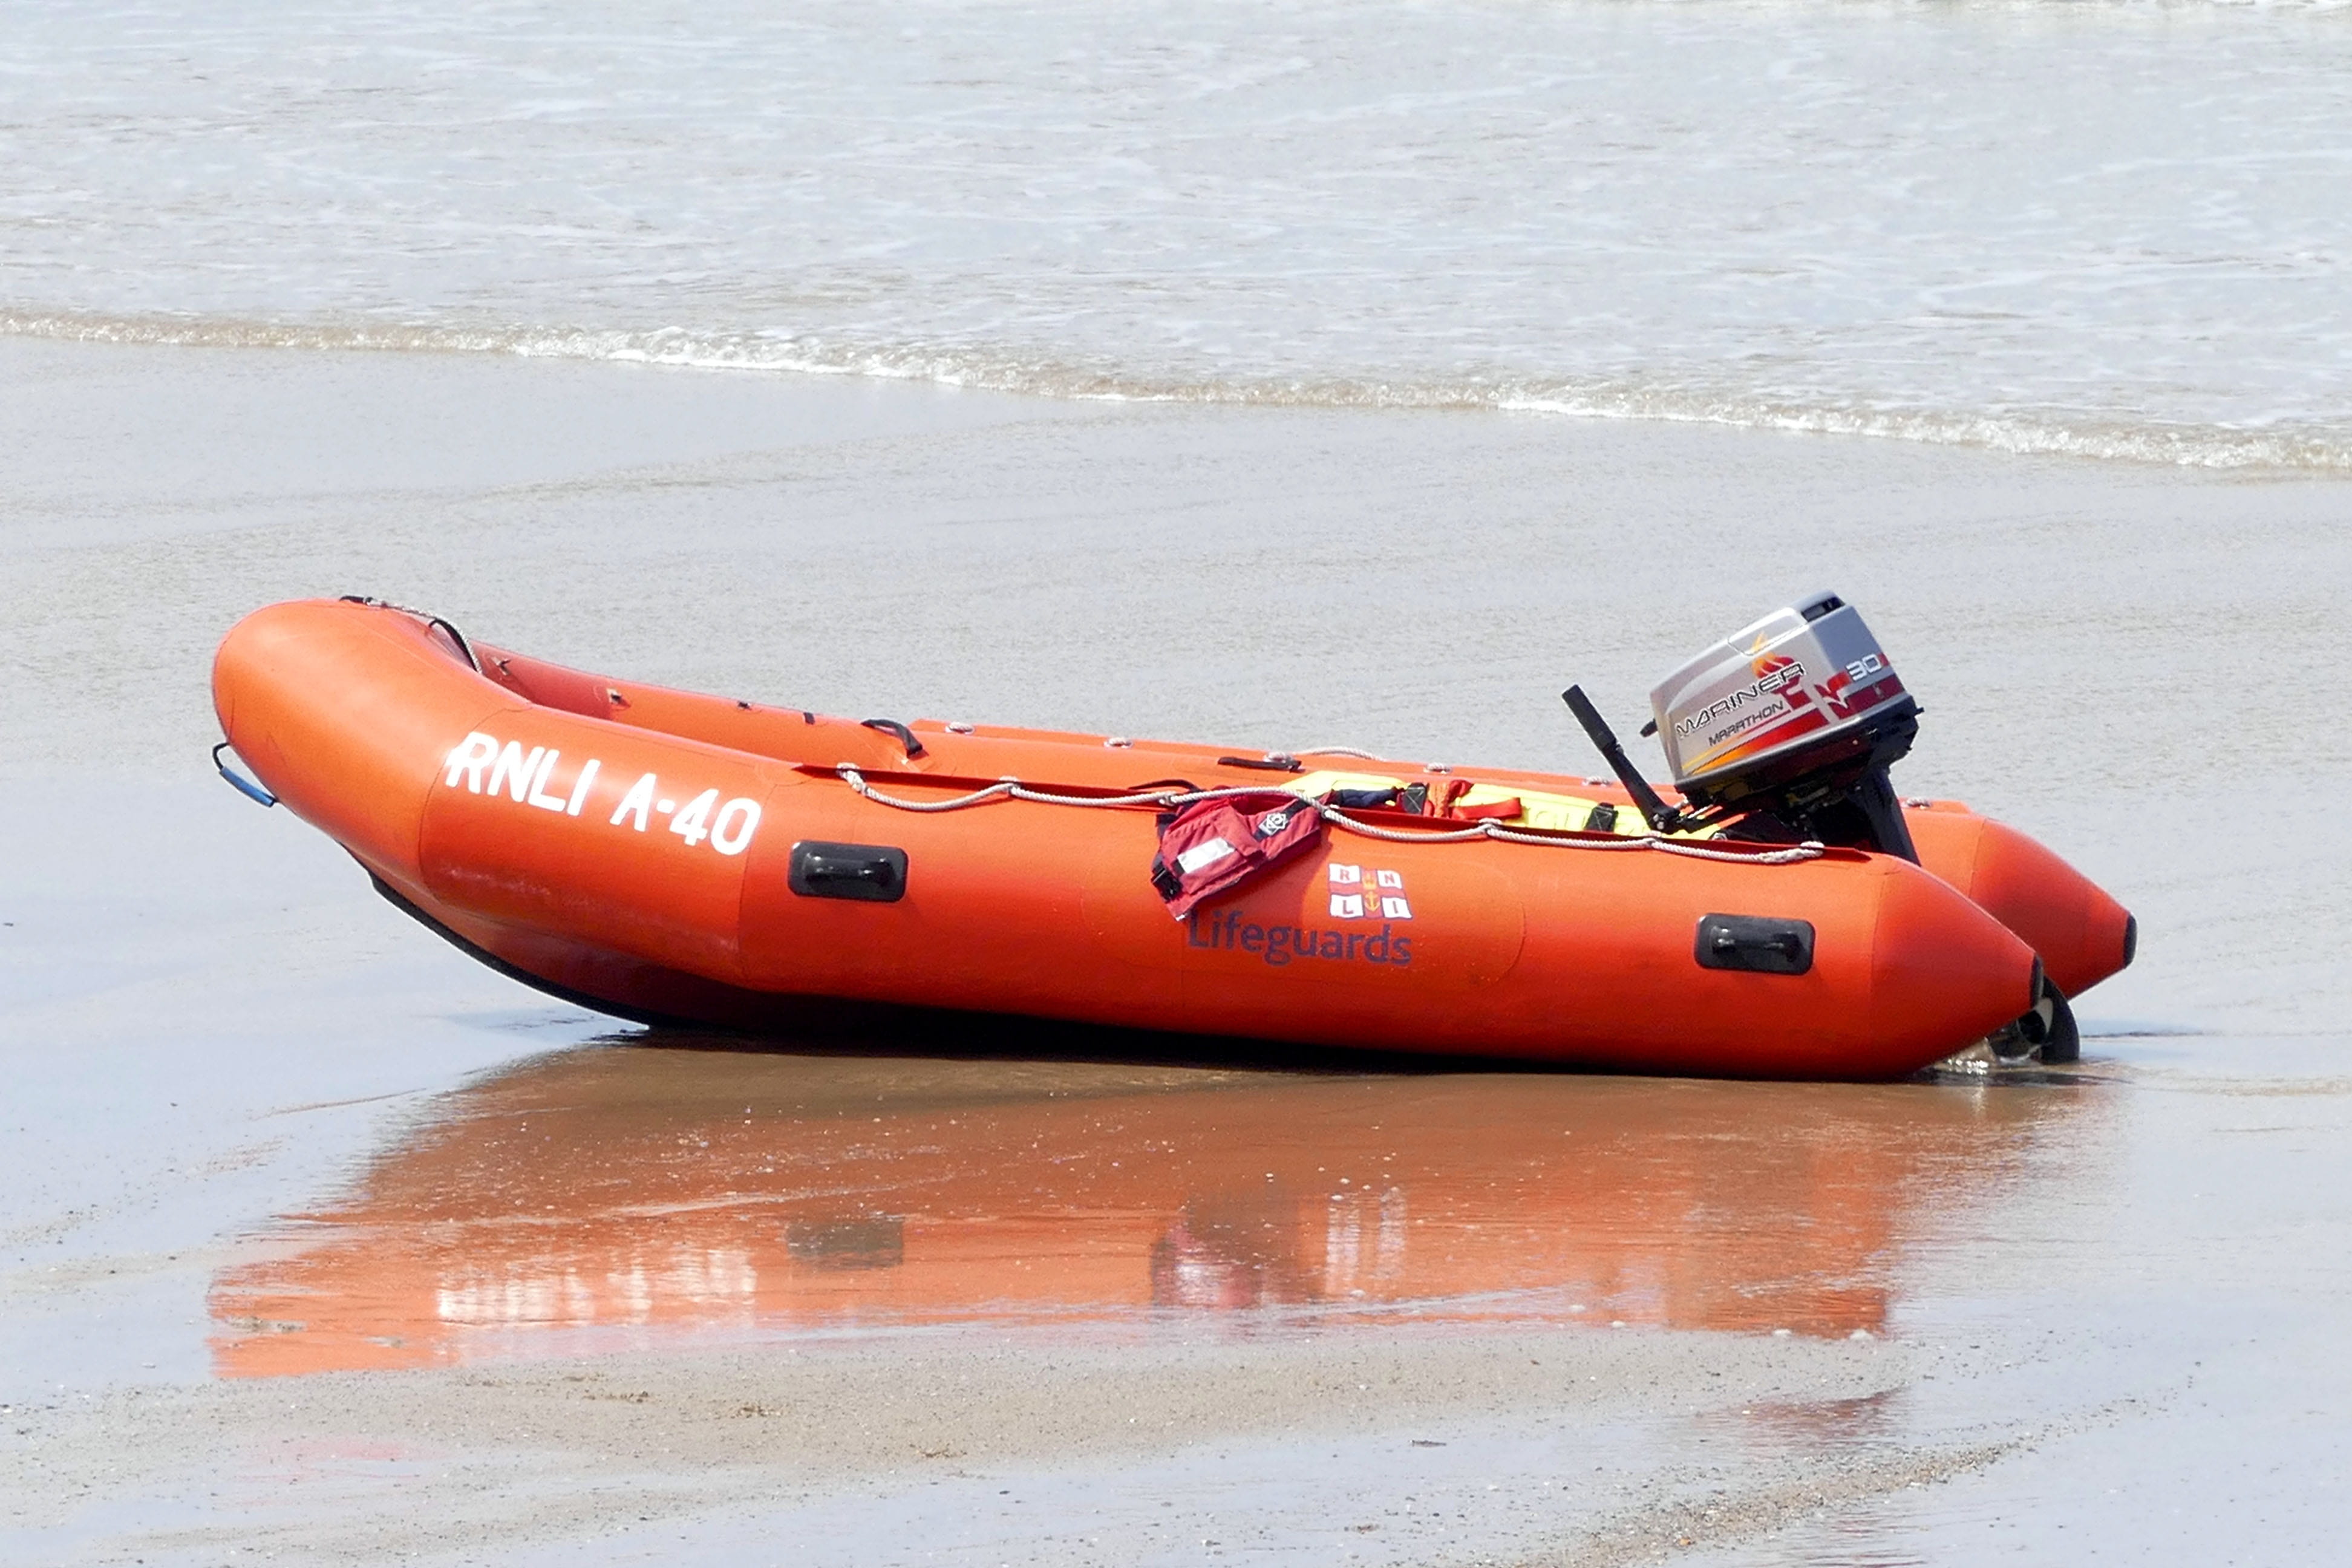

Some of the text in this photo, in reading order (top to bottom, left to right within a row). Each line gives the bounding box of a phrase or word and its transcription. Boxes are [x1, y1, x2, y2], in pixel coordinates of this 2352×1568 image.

[1846, 653, 1882, 682] 30
[1675, 662, 1808, 739] MARINER
[1708, 700, 1784, 746] MARATHON
[445, 732, 762, 855] RNLI A-40
[1187, 907, 1412, 966] Lifeguards
